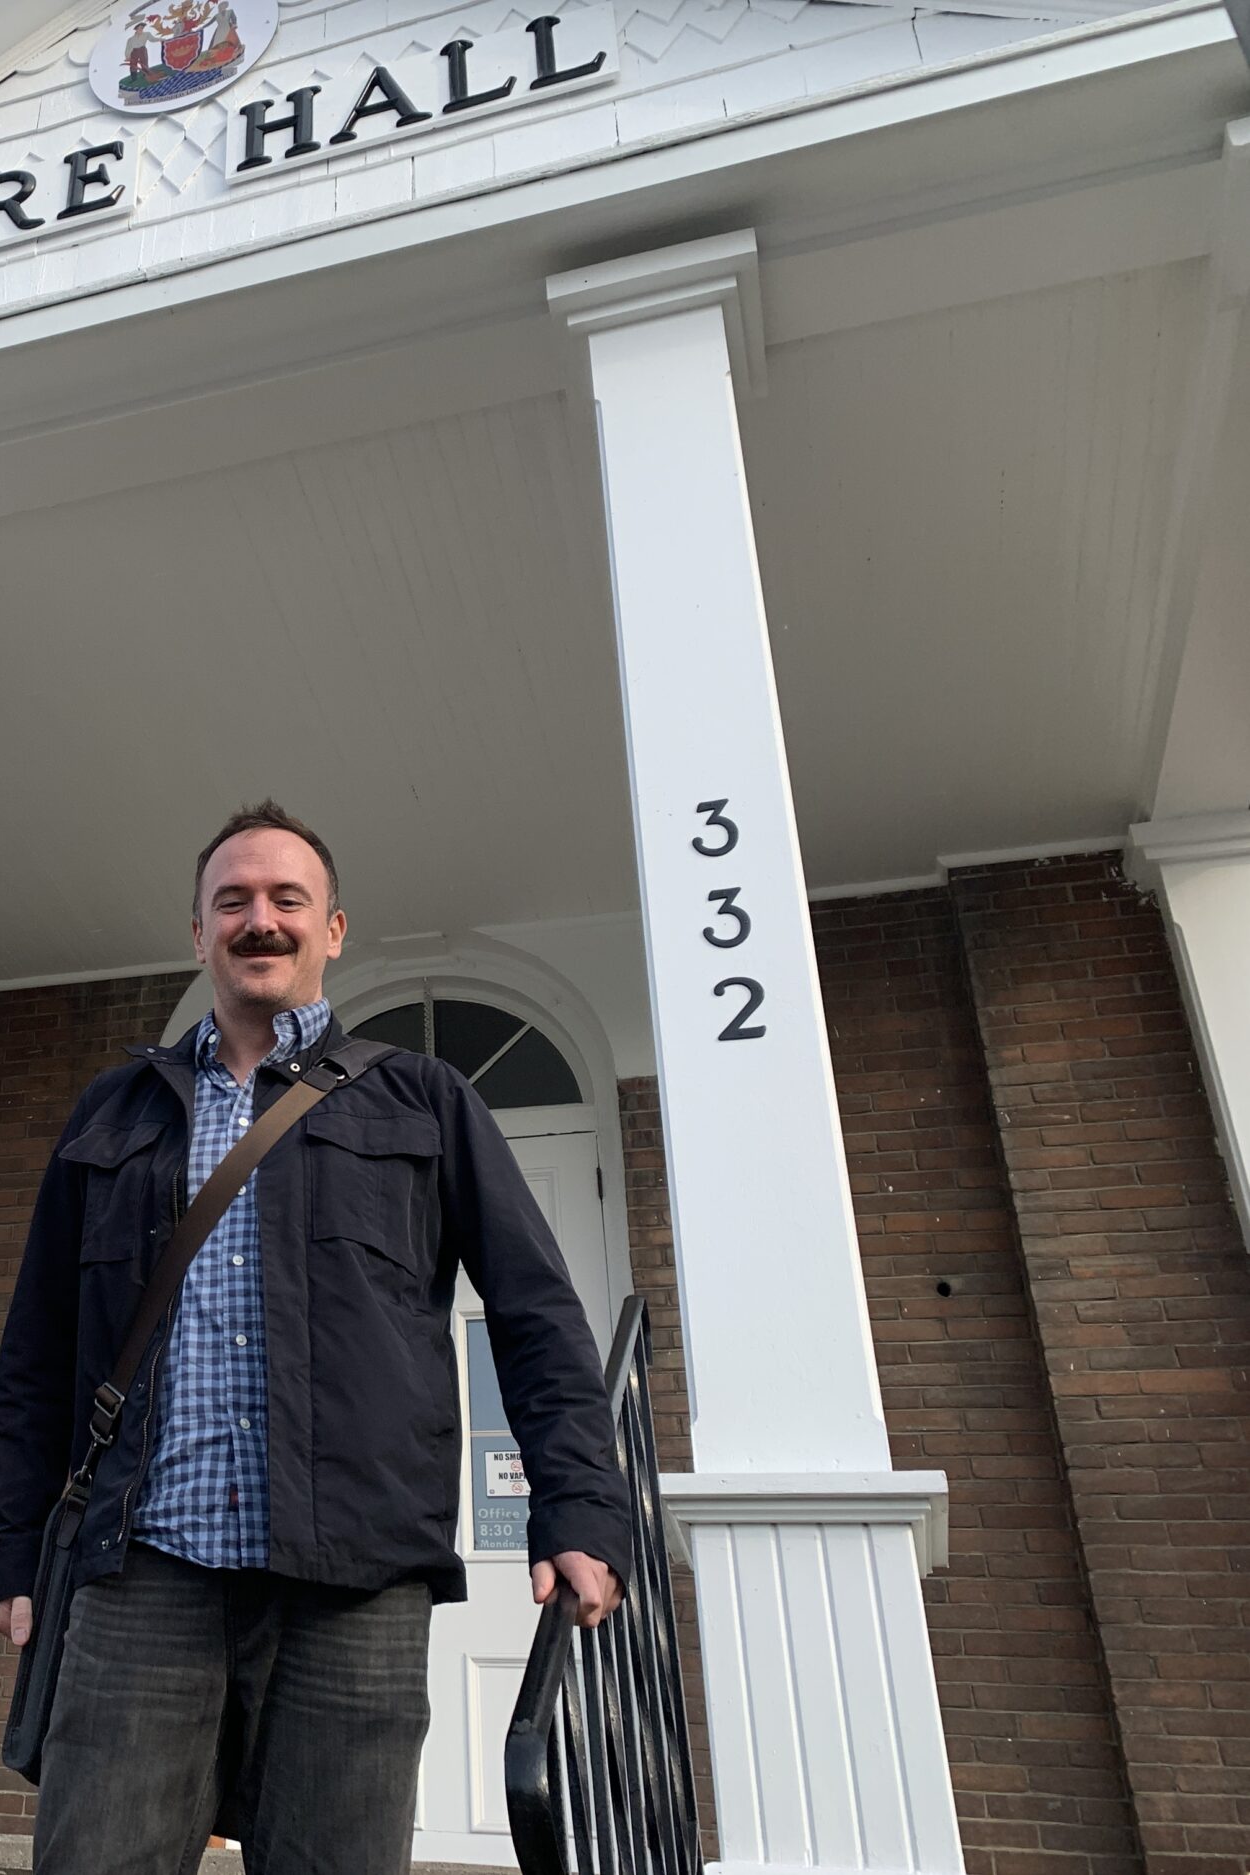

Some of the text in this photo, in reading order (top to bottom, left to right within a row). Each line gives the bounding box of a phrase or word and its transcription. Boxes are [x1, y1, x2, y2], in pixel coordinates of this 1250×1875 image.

[236, 15, 607, 172] HALL
[494, 1453, 503, 1461] NO
[499, 1472, 508, 1480] NO
[478, 1508, 520, 1519] Office
[480, 1524, 512, 1537] 8:30
[480, 1539, 522, 1549] Monday
